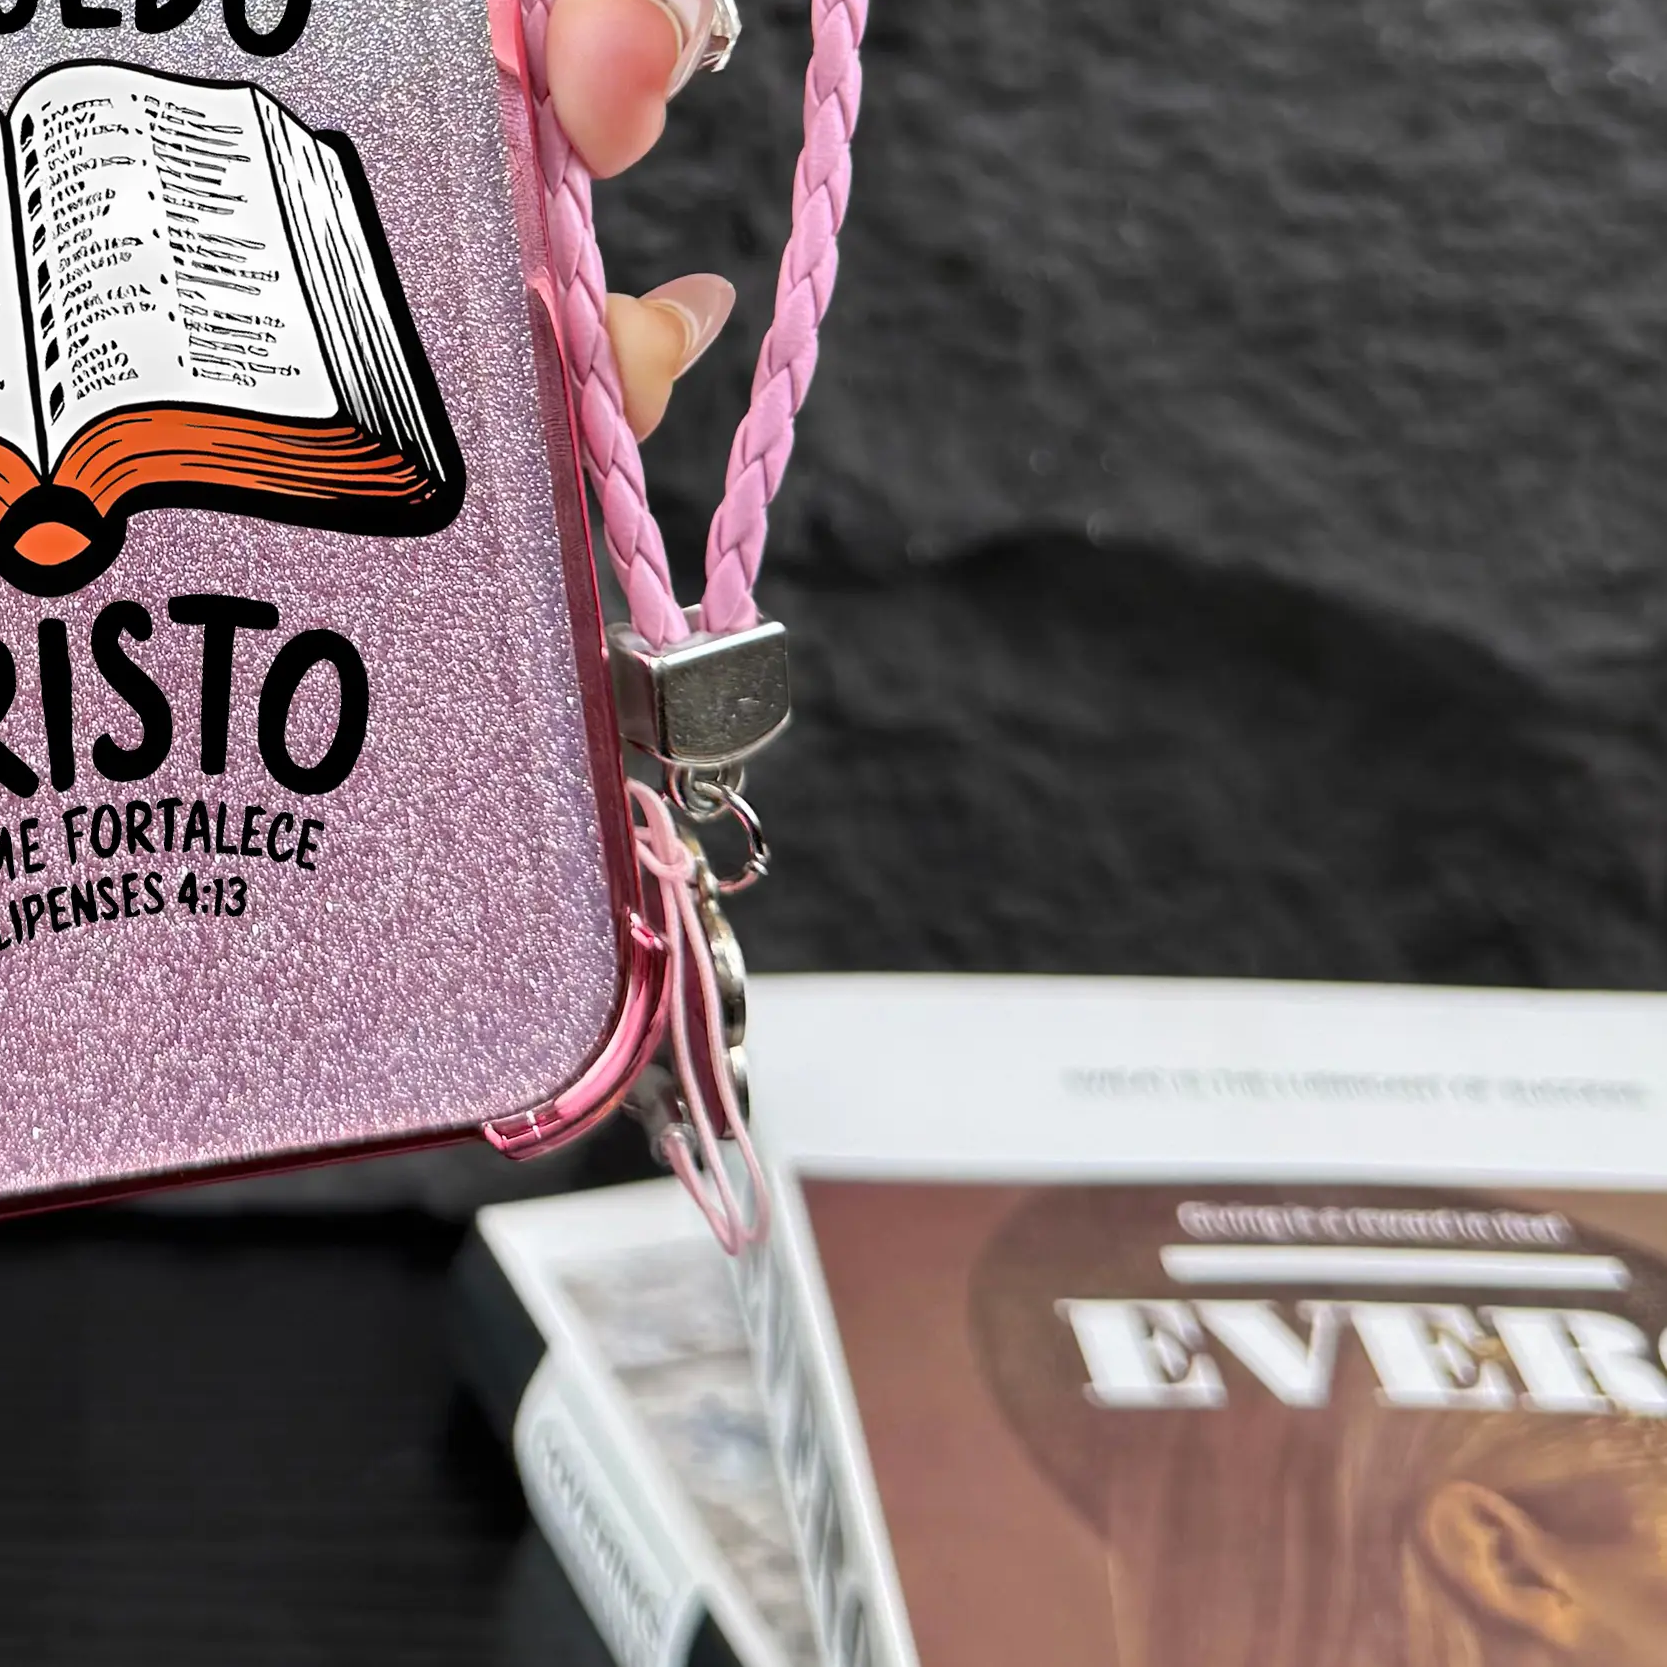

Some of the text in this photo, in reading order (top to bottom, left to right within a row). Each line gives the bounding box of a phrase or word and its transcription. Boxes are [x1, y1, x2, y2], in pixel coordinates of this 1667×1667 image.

[62, 797, 325, 871] FORTALECE
[178, 872, 248, 918] 4:13
[1054, 1298, 1667, 1415] EVER
